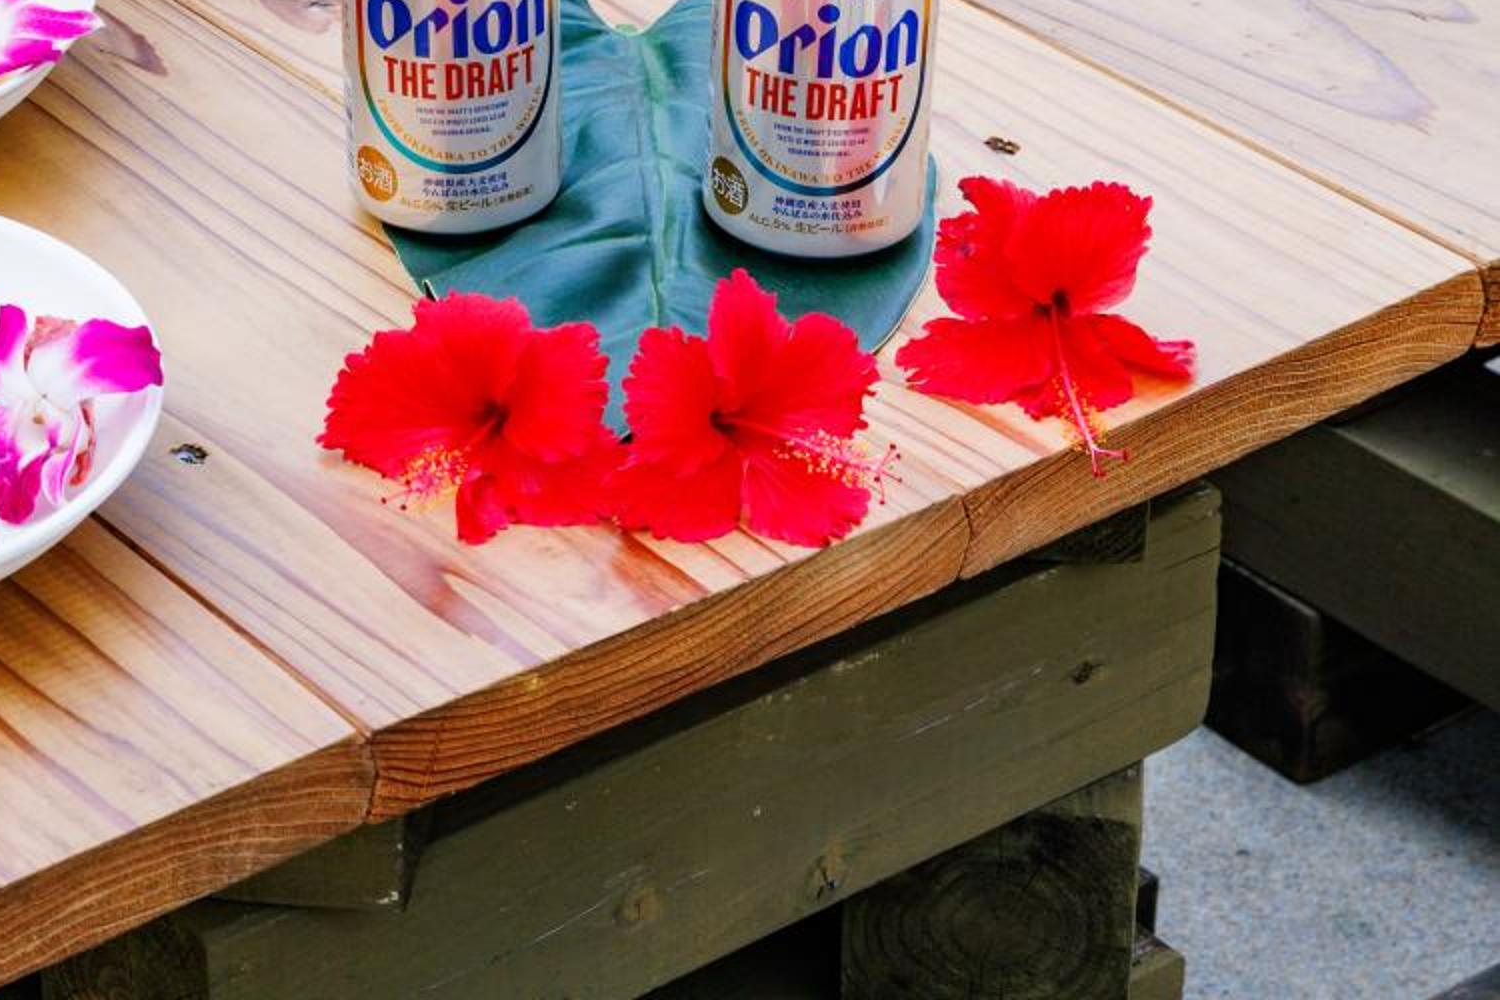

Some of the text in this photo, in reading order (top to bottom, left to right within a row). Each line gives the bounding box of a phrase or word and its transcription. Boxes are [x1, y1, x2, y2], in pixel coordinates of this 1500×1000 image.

[735, 0, 919, 79] Orion
[383, 46, 535, 100] THE DRAFT
[746, 66, 904, 121] THE DRAFT
[357, 155, 394, 193] お酒
[712, 167, 744, 210] お酒
